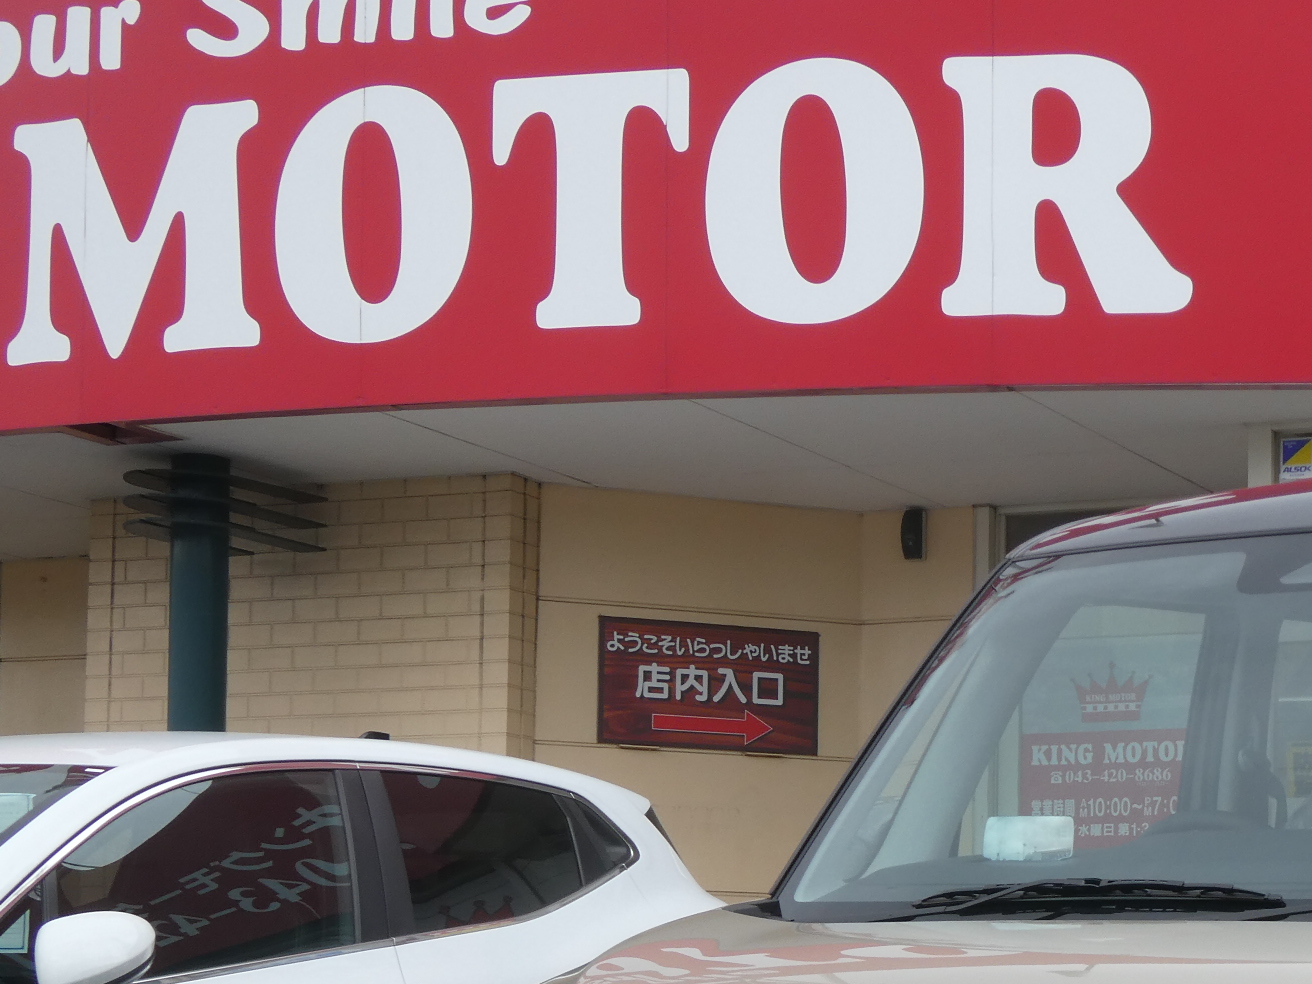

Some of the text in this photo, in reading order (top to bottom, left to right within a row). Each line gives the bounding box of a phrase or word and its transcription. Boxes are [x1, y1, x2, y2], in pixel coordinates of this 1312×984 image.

[6, 53, 1194, 367] MOTOR
[606, 631, 812, 665] ようこそいらっしゃいませ
[635, 662, 784, 706] 店内入口
[1030, 743, 1094, 766] KING
[1065, 767, 1172, 784] 043-420-8686
